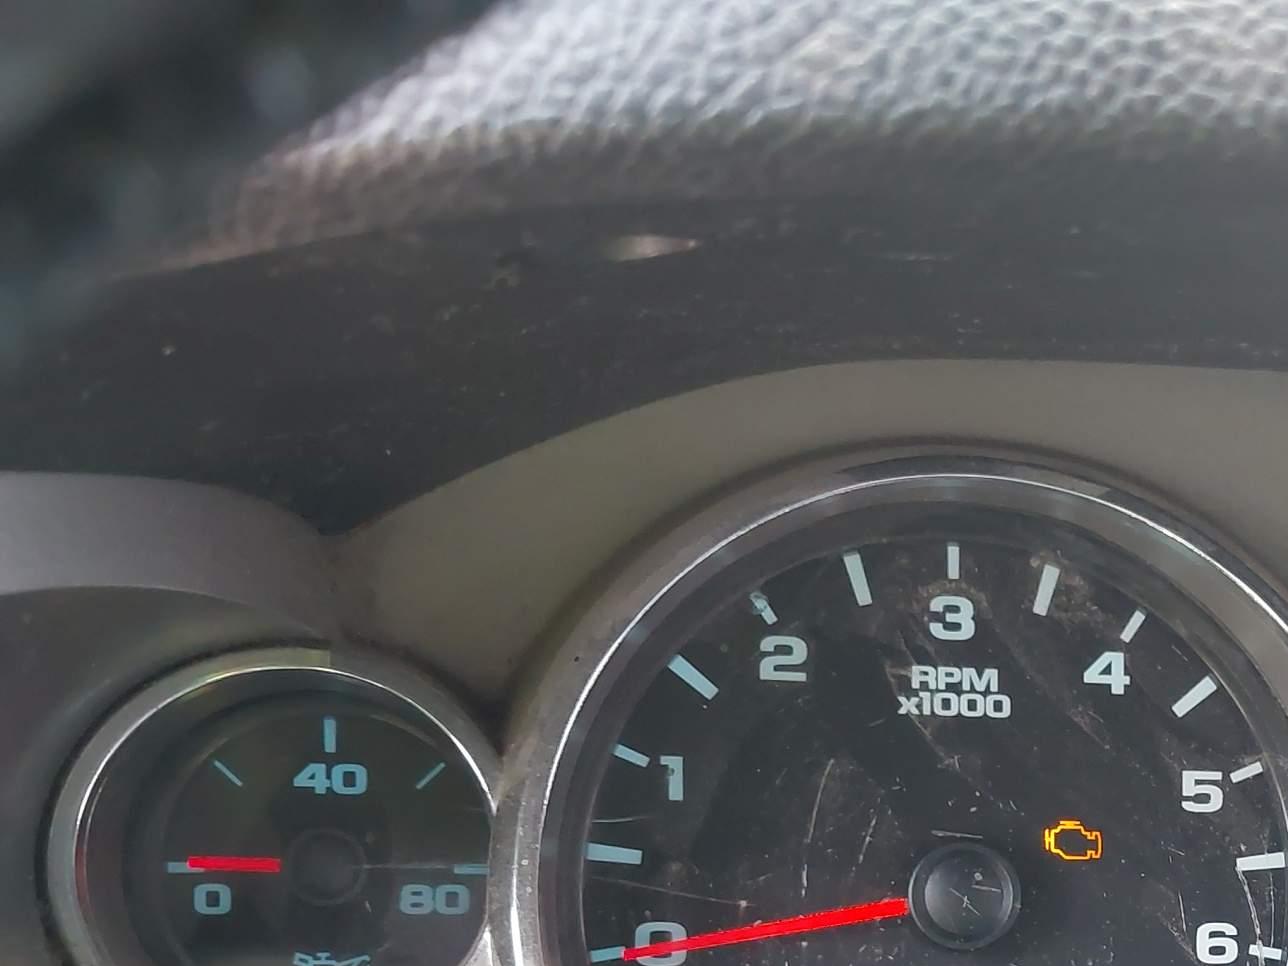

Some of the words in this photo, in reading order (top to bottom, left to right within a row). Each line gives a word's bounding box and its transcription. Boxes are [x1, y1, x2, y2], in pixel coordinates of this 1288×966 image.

[929, 596, 975, 640] 3
[759, 636, 808, 682] 2
[911, 666, 998, 692] RPM
[1083, 652, 1130, 695] 4
[897, 692, 1011, 719] x1000
[293, 763, 368, 795] 40
[660, 756, 684, 800] 1
[1181, 770, 1224, 813] 5
[193, 884, 231, 915] 0
[399, 884, 470, 915] 80
[1196, 922, 1238, 965] 6
